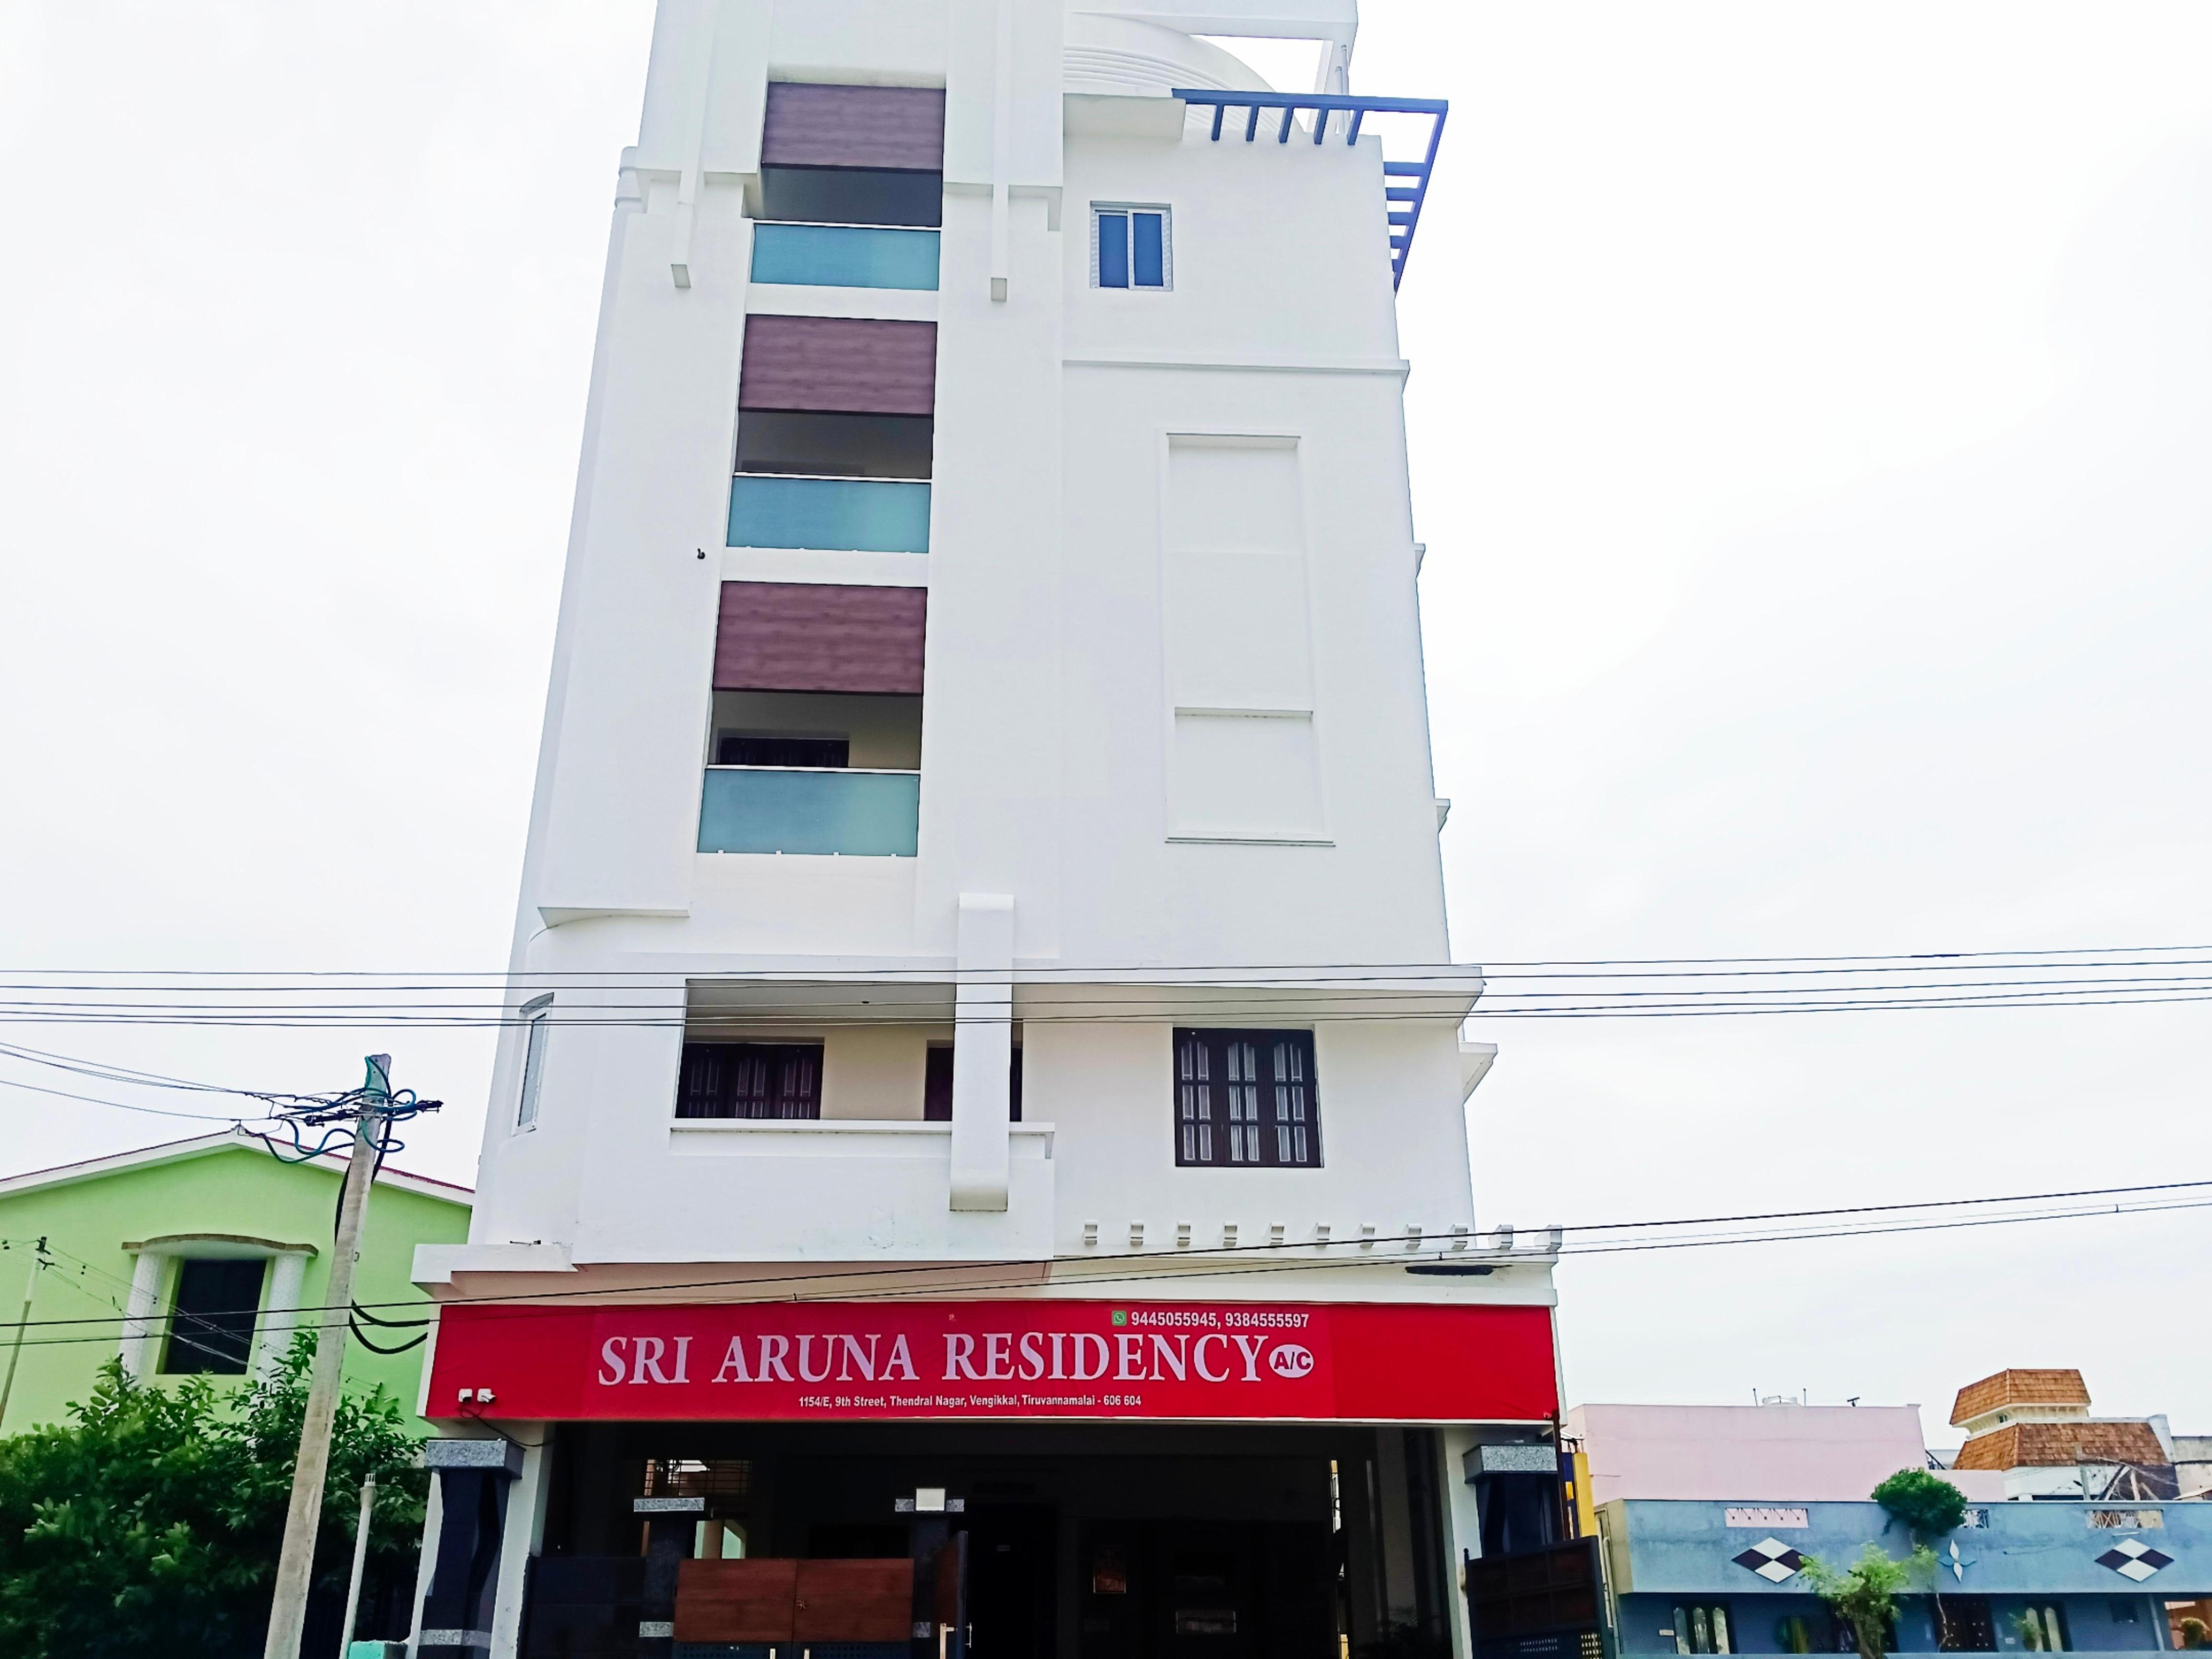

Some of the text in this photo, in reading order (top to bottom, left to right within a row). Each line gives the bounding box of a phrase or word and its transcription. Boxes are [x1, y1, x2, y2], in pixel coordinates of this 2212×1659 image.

[1131, 1311, 1310, 1330] 9445055945, 9384555597
[598, 1332, 1269, 1386] SRI ARUNA RESIDENCY
[1273, 1351, 1311, 1370] A/C
[798, 1396, 833, 1409] 1154/E,
[835, 1396, 851, 1407] 9th
[853, 1396, 887, 1409] Street,
[889, 1395, 932, 1406] Thendral
[935, 1395, 967, 1409] Nagar,
[969, 1395, 1020, 1408] Vengikkal,
[1021, 1394, 1096, 1406] Tiruvannamalai
[1103, 1395, 1121, 1406] 606
[1123, 1395, 1142, 1406] 604
